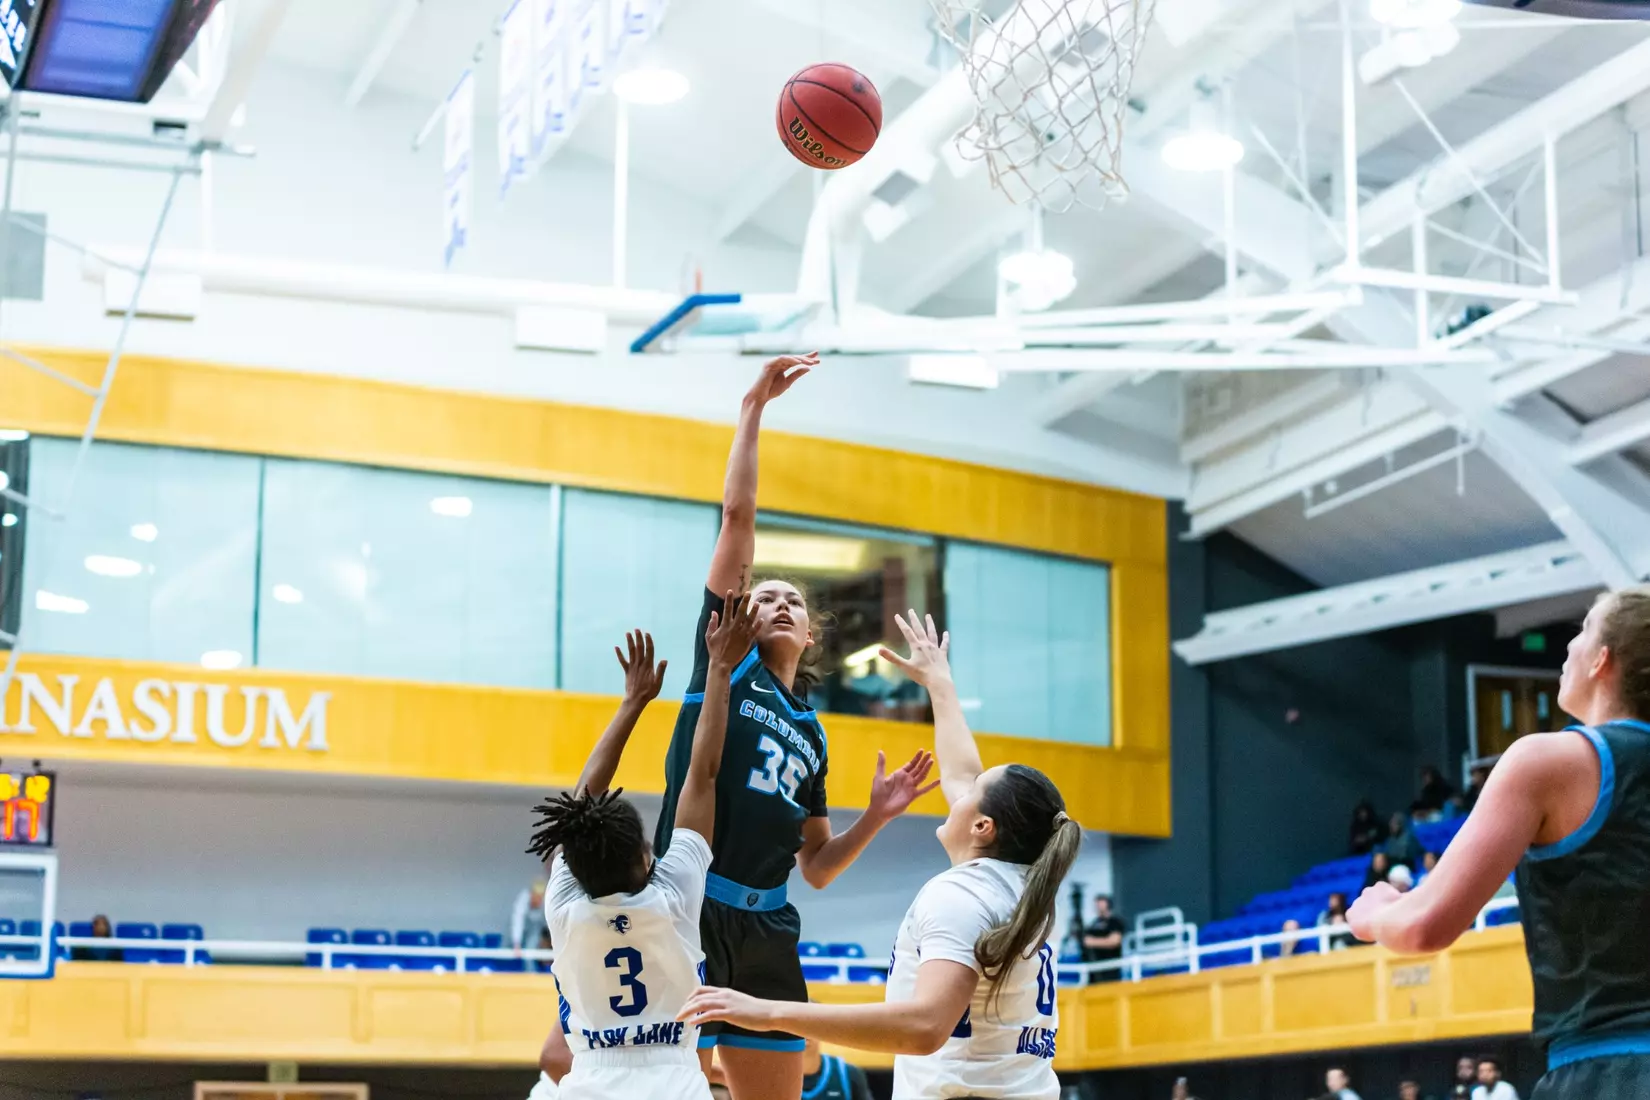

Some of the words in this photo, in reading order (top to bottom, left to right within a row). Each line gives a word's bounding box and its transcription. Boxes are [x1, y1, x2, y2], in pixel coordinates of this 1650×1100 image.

[789, 116, 847, 166] Wilson
[740, 699, 821, 775] COLUMBIA
[746, 732, 809, 808] 35
[604, 946, 648, 1017] 3
